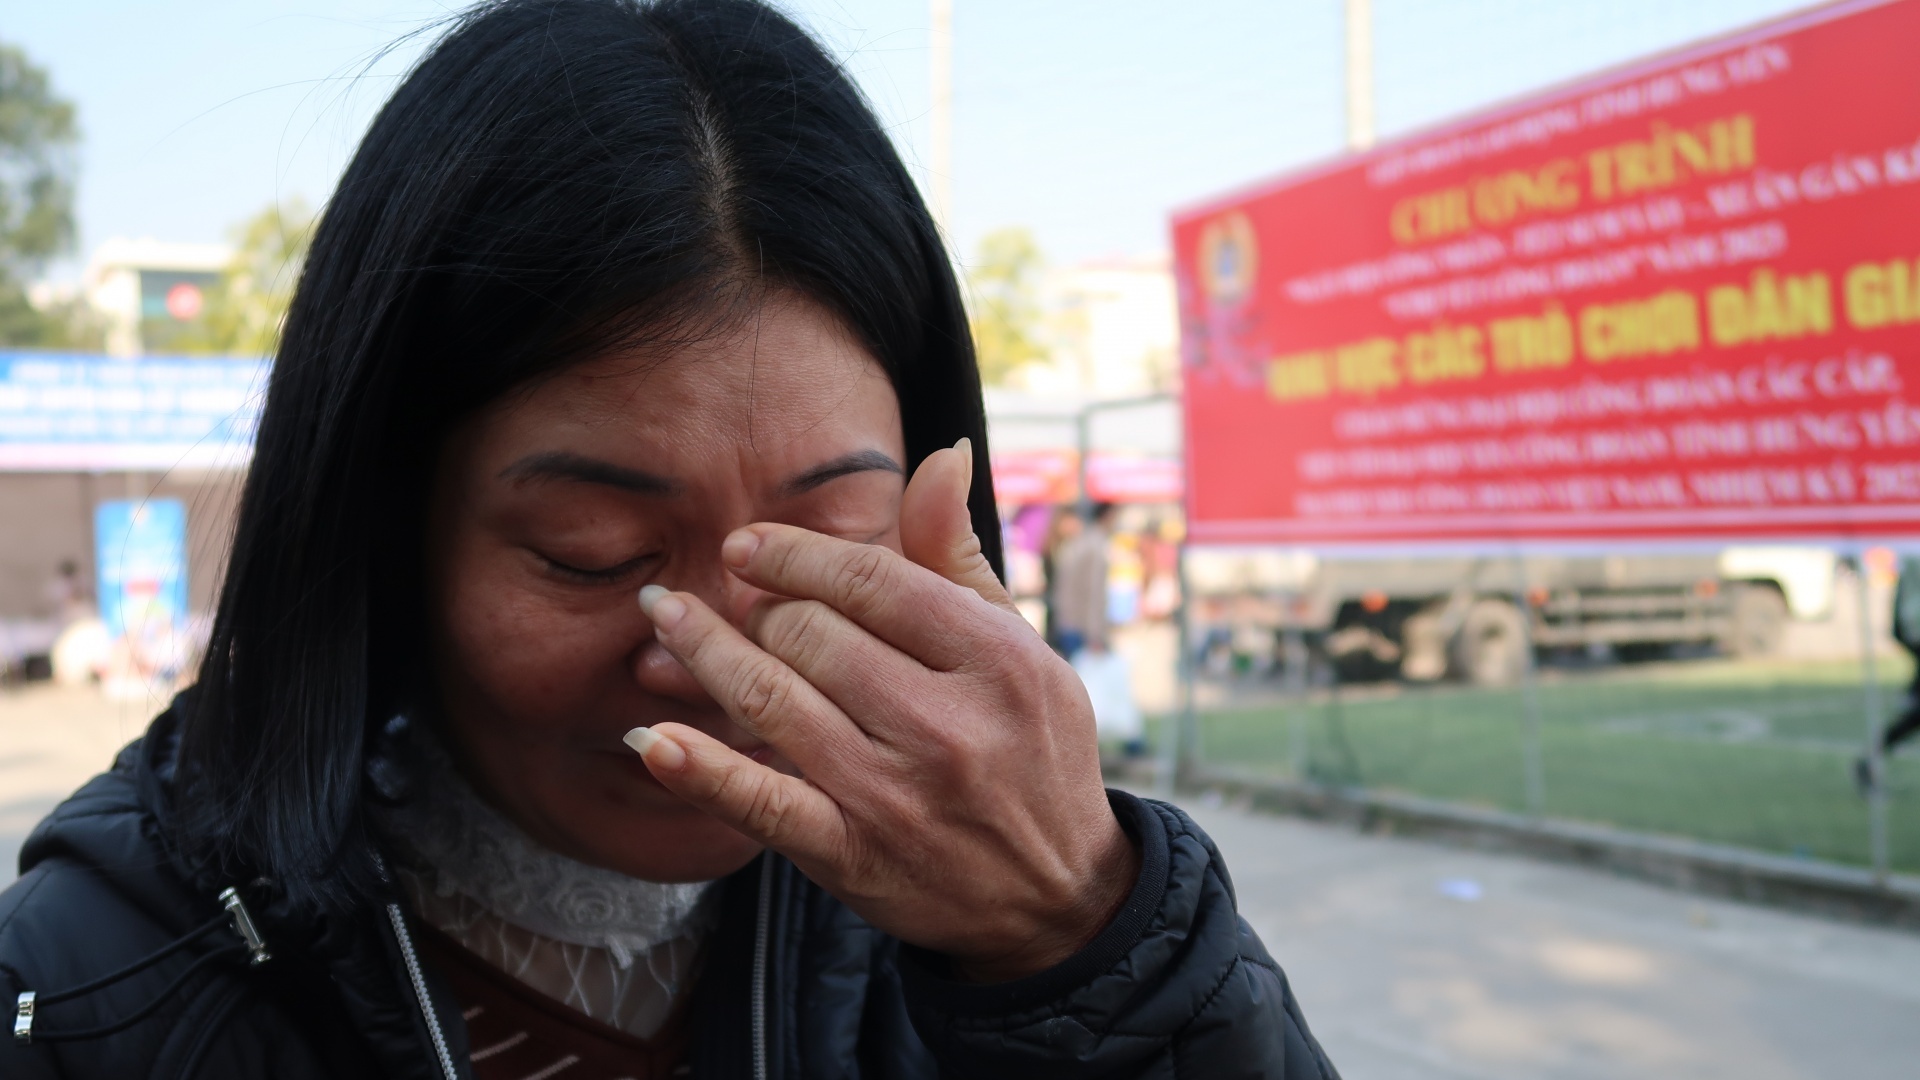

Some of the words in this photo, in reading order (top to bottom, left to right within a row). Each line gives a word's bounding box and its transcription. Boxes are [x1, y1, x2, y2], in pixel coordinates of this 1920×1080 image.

[1391, 162, 1577, 242] CHƯƠNG
[1589, 116, 1754, 197] TRÌNH
[1404, 326, 1484, 383] CÁC
[1845, 261, 1920, 327] GI
